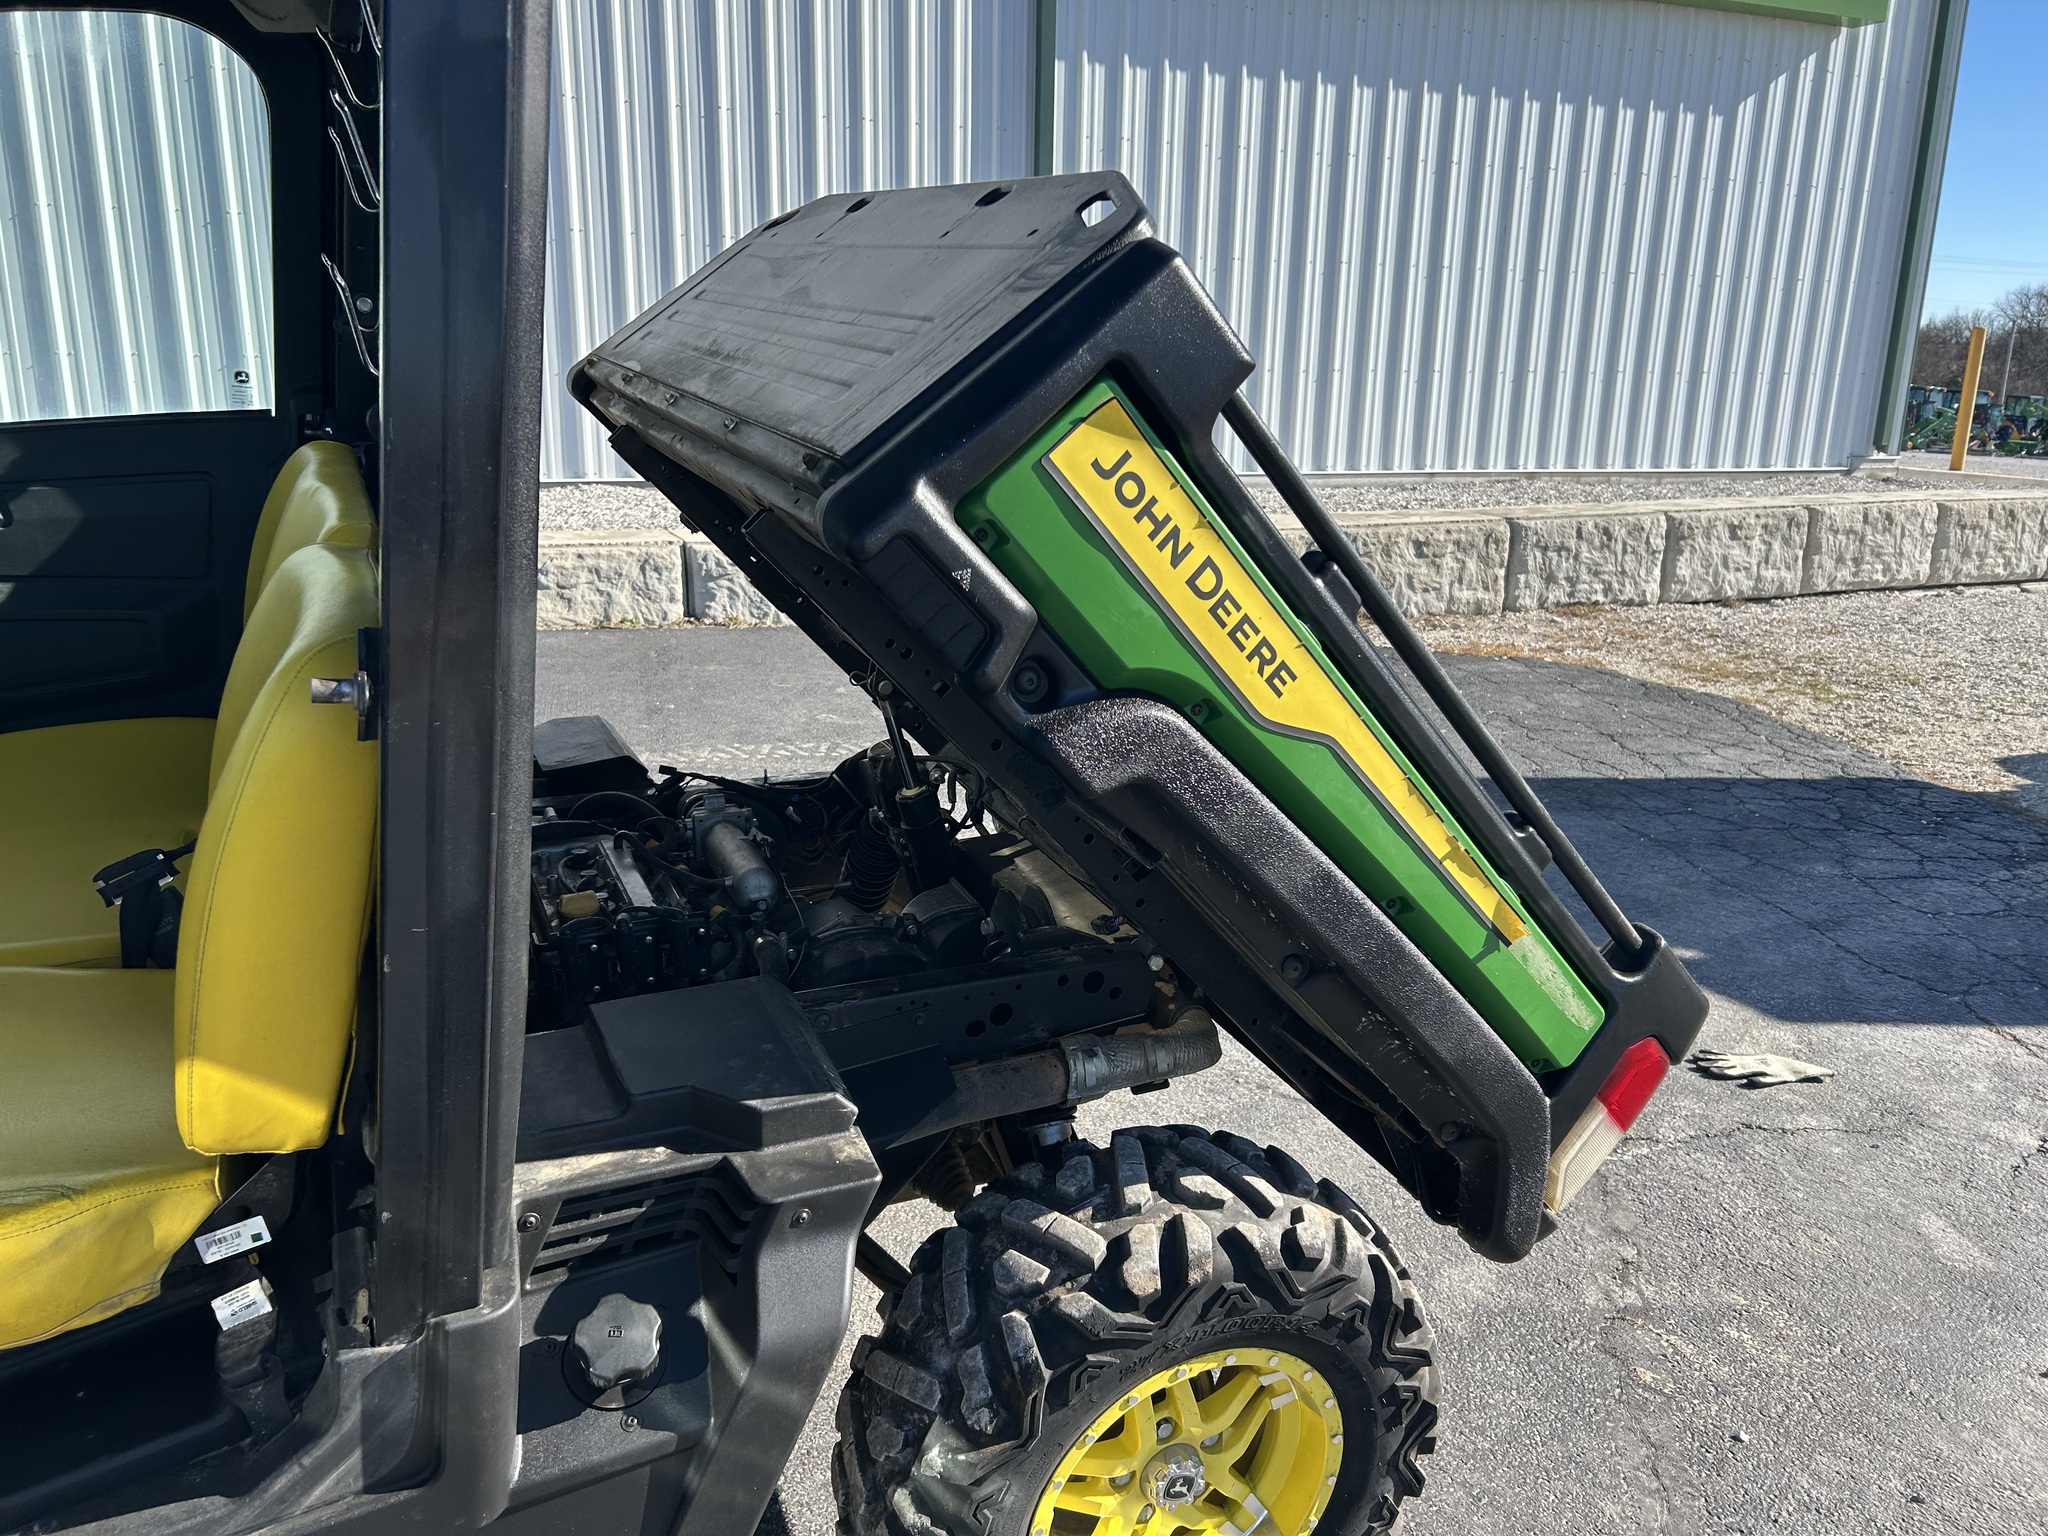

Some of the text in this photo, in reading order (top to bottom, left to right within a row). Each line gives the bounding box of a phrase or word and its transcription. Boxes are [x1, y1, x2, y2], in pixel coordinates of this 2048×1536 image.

[1091, 450, 1298, 699] JOHN DEERE
[238, 1300, 258, 1313] SHIELD
